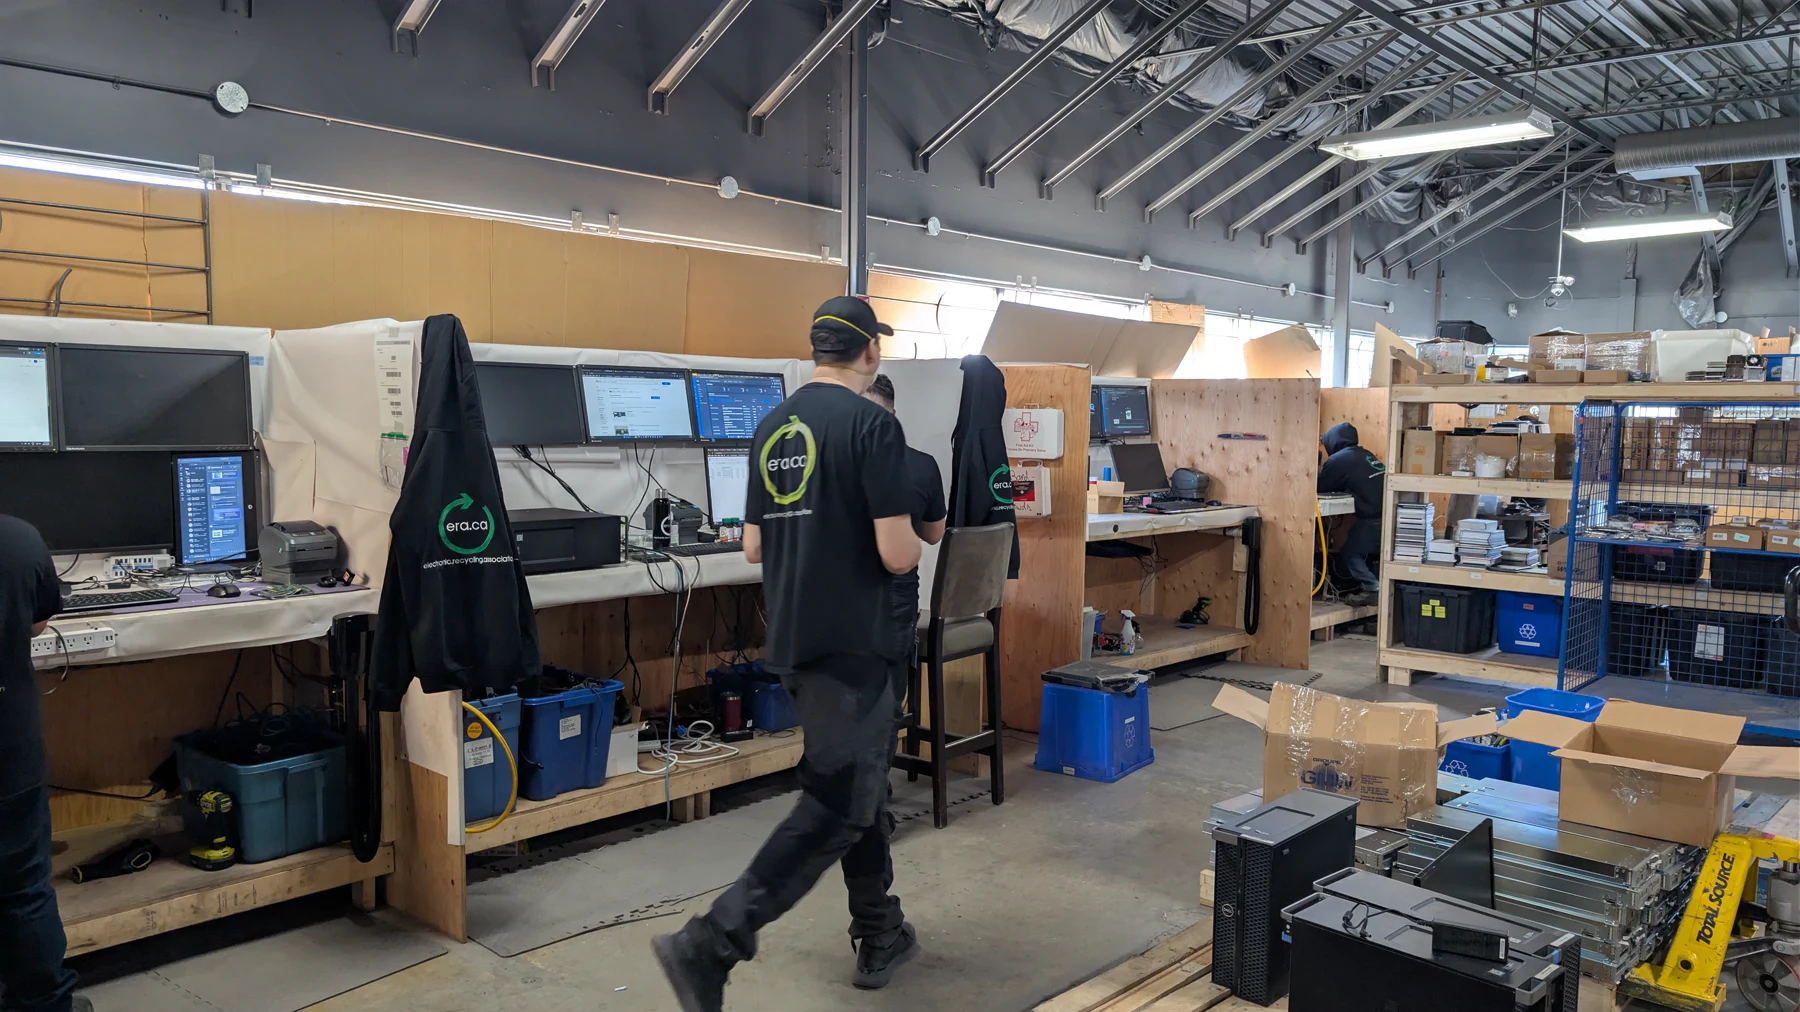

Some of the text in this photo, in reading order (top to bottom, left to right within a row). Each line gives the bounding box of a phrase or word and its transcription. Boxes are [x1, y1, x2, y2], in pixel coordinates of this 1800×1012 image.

[446, 520, 489, 532] era.ca
[1696, 853, 1735, 945] TOTAL SOURCE
